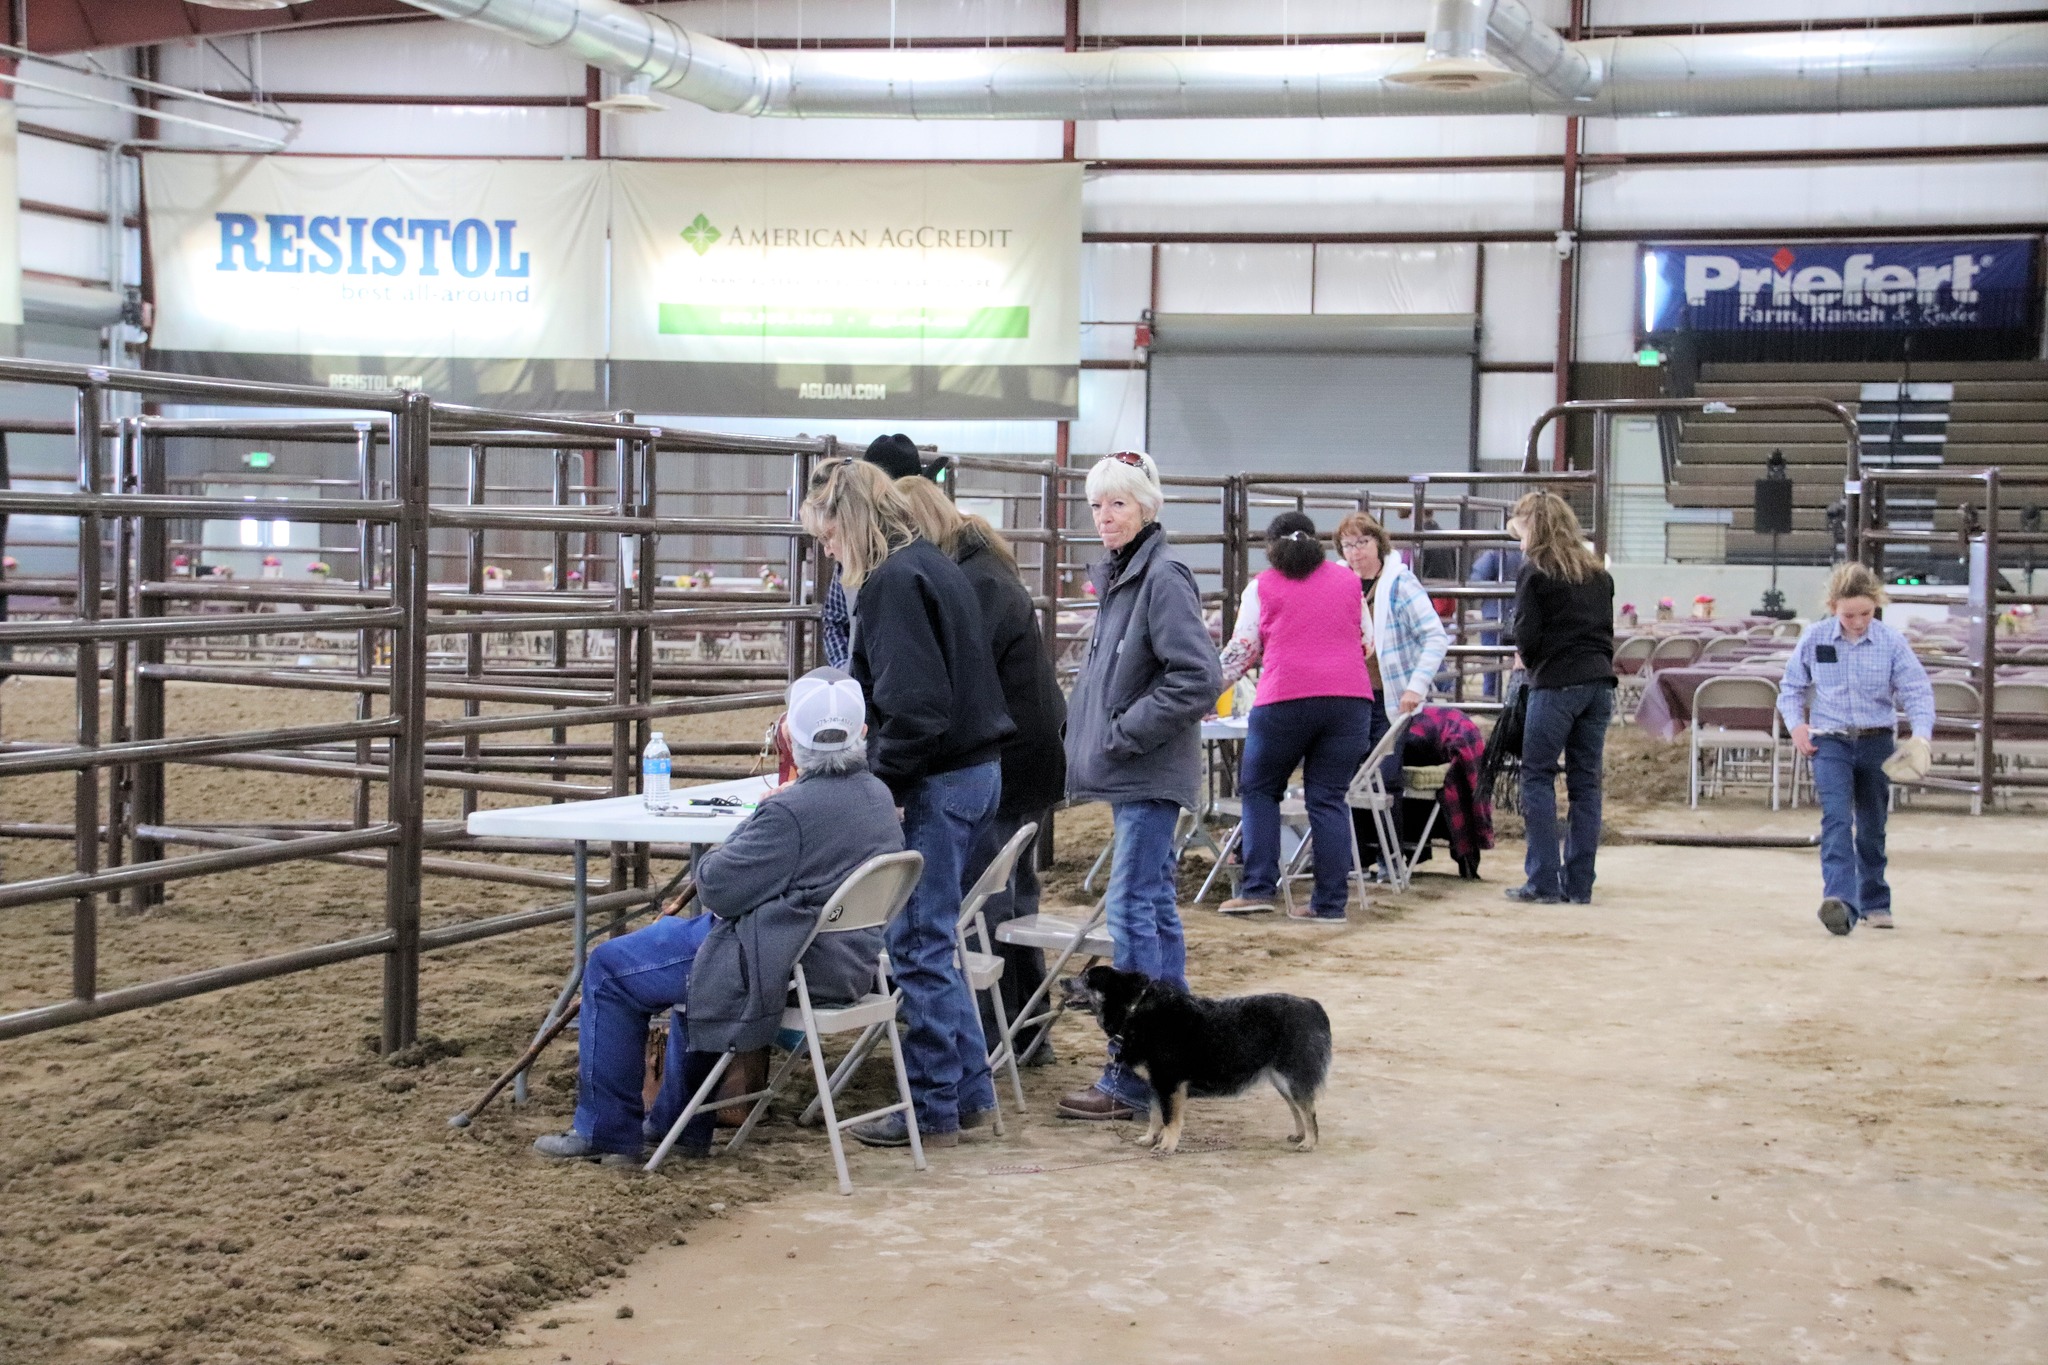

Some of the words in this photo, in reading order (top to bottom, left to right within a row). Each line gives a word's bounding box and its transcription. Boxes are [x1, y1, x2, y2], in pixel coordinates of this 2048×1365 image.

[215, 212, 530, 278] RESISTOL
[728, 225, 868, 248] AMERICAN
[1811, 305, 1885, 323] Ranch
[799, 383, 886, 400] AGLOAN.COM
